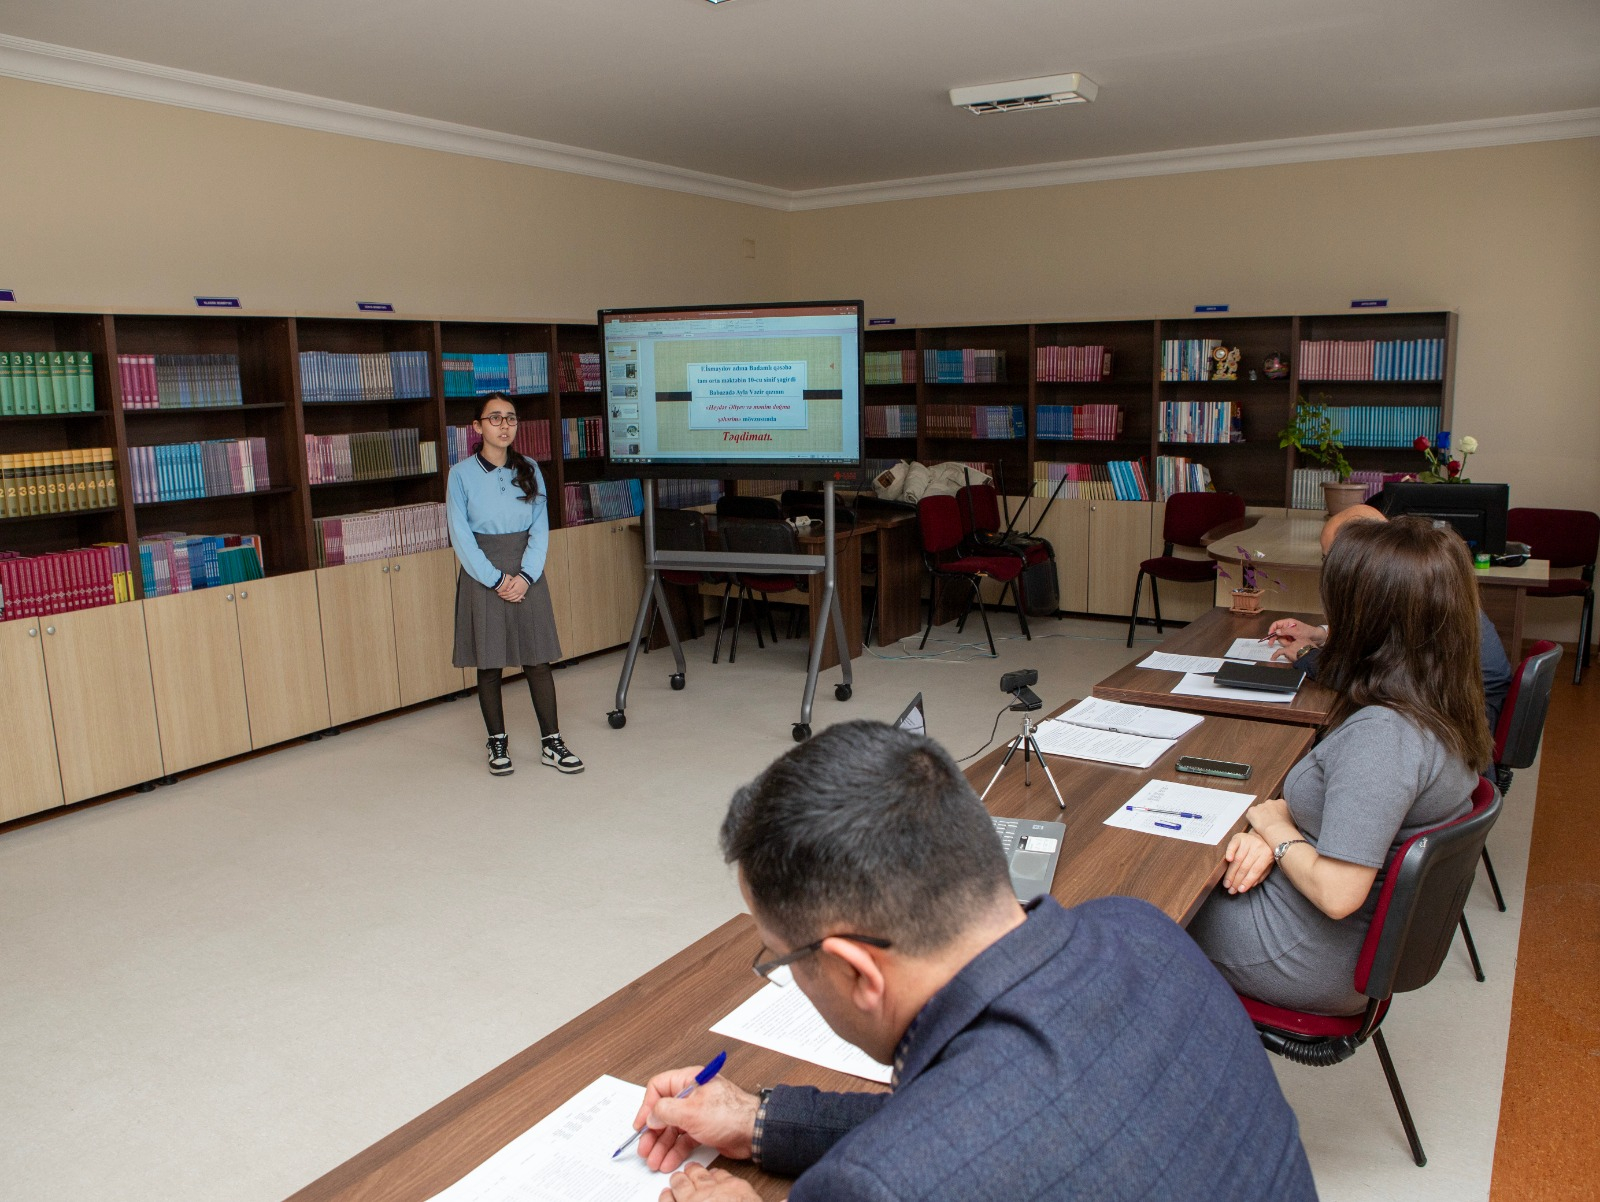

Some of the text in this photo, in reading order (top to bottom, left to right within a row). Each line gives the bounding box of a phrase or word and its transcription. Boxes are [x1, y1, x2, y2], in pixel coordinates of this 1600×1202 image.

[1, 356, 8, 365] 3
[14, 356, 22, 365] 3
[26, 356, 33, 364] 3
[39, 356, 46, 364] 4
[54, 355, 62, 364] 4
[68, 355, 75, 364] 4
[82, 355, 90, 364] 4
[722, 431, 773, 444] Təqdimatı.
[58, 483, 66, 493] 3
[68, 482, 76, 492] 4
[78, 481, 86, 491] 4
[88, 480, 96, 490] 4
[98, 479, 106, 489] 4
[107, 478, 115, 488] 4
[8, 487, 16, 497] 2
[19, 486, 27, 496] 3
[29, 486, 37, 495] 3
[38, 484, 47, 494] 3
[48, 484, 56, 494] 3
